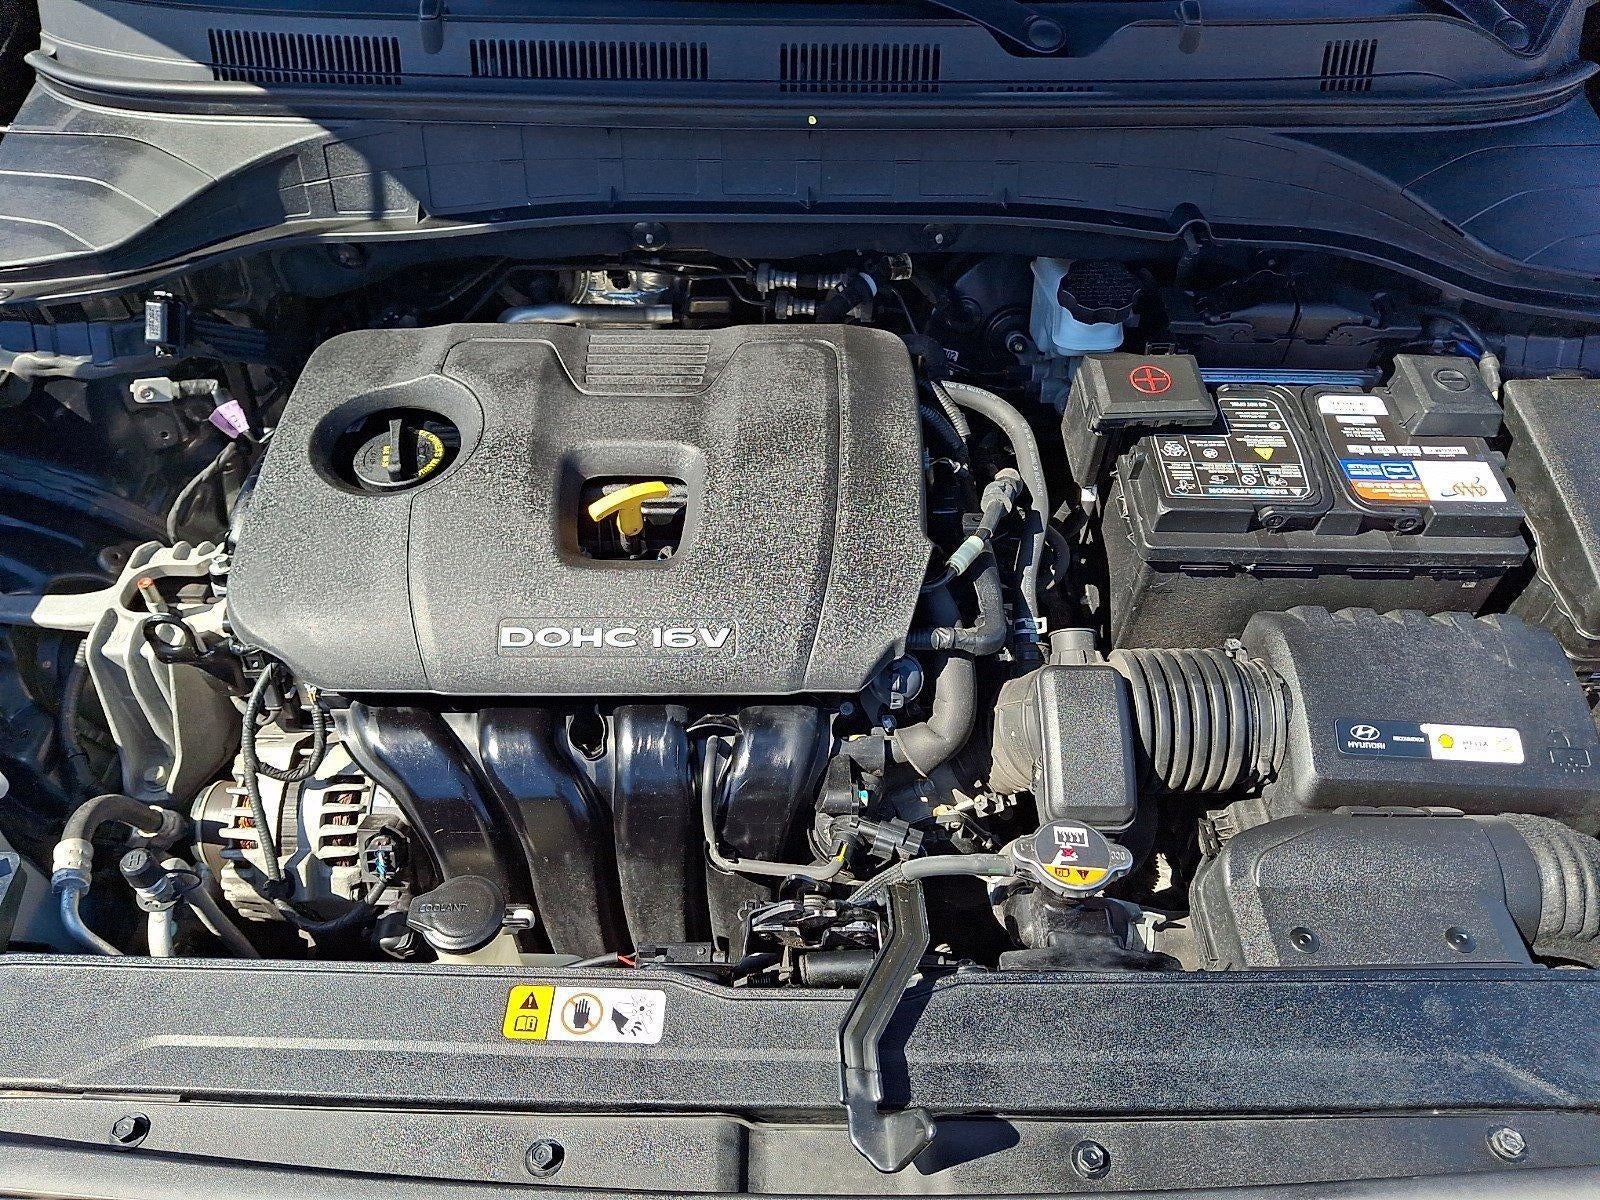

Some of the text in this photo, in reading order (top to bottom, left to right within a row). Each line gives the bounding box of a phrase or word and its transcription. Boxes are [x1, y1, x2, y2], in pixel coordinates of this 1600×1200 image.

[500, 626, 733, 648] DOHC 16V
[1347, 740, 1386, 750] HYUNDAI
[418, 903, 467, 913] COOLANT
